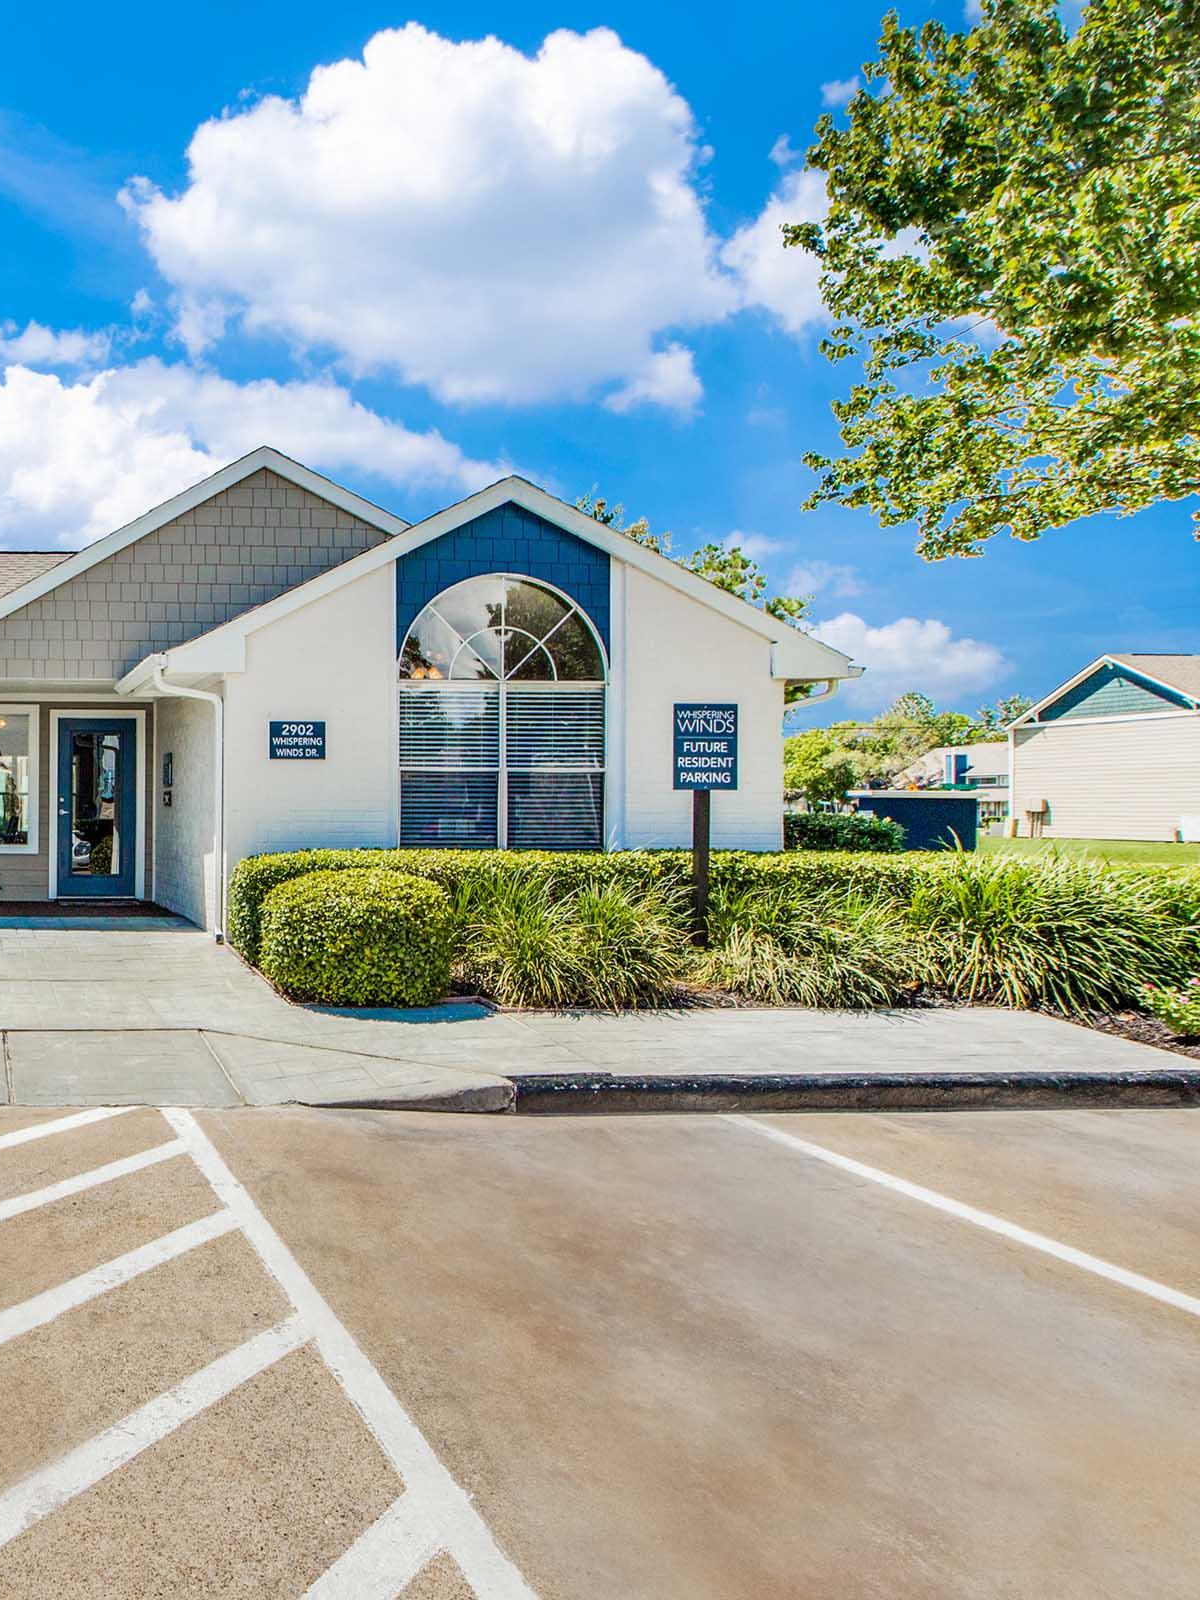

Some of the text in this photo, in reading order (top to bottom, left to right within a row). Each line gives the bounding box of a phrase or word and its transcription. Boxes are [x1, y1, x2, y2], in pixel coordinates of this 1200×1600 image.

[677, 710, 735, 719] WHISPERING
[281, 724, 314, 736] 2902
[677, 719, 735, 733] WINDS
[272, 737, 323, 746] WHISPERING
[275, 748, 320, 757] WINDS DR.
[683, 742, 728, 753] FUTURE
[677, 757, 734, 768] RESIDENT
[680, 772, 731, 783] PARKING
